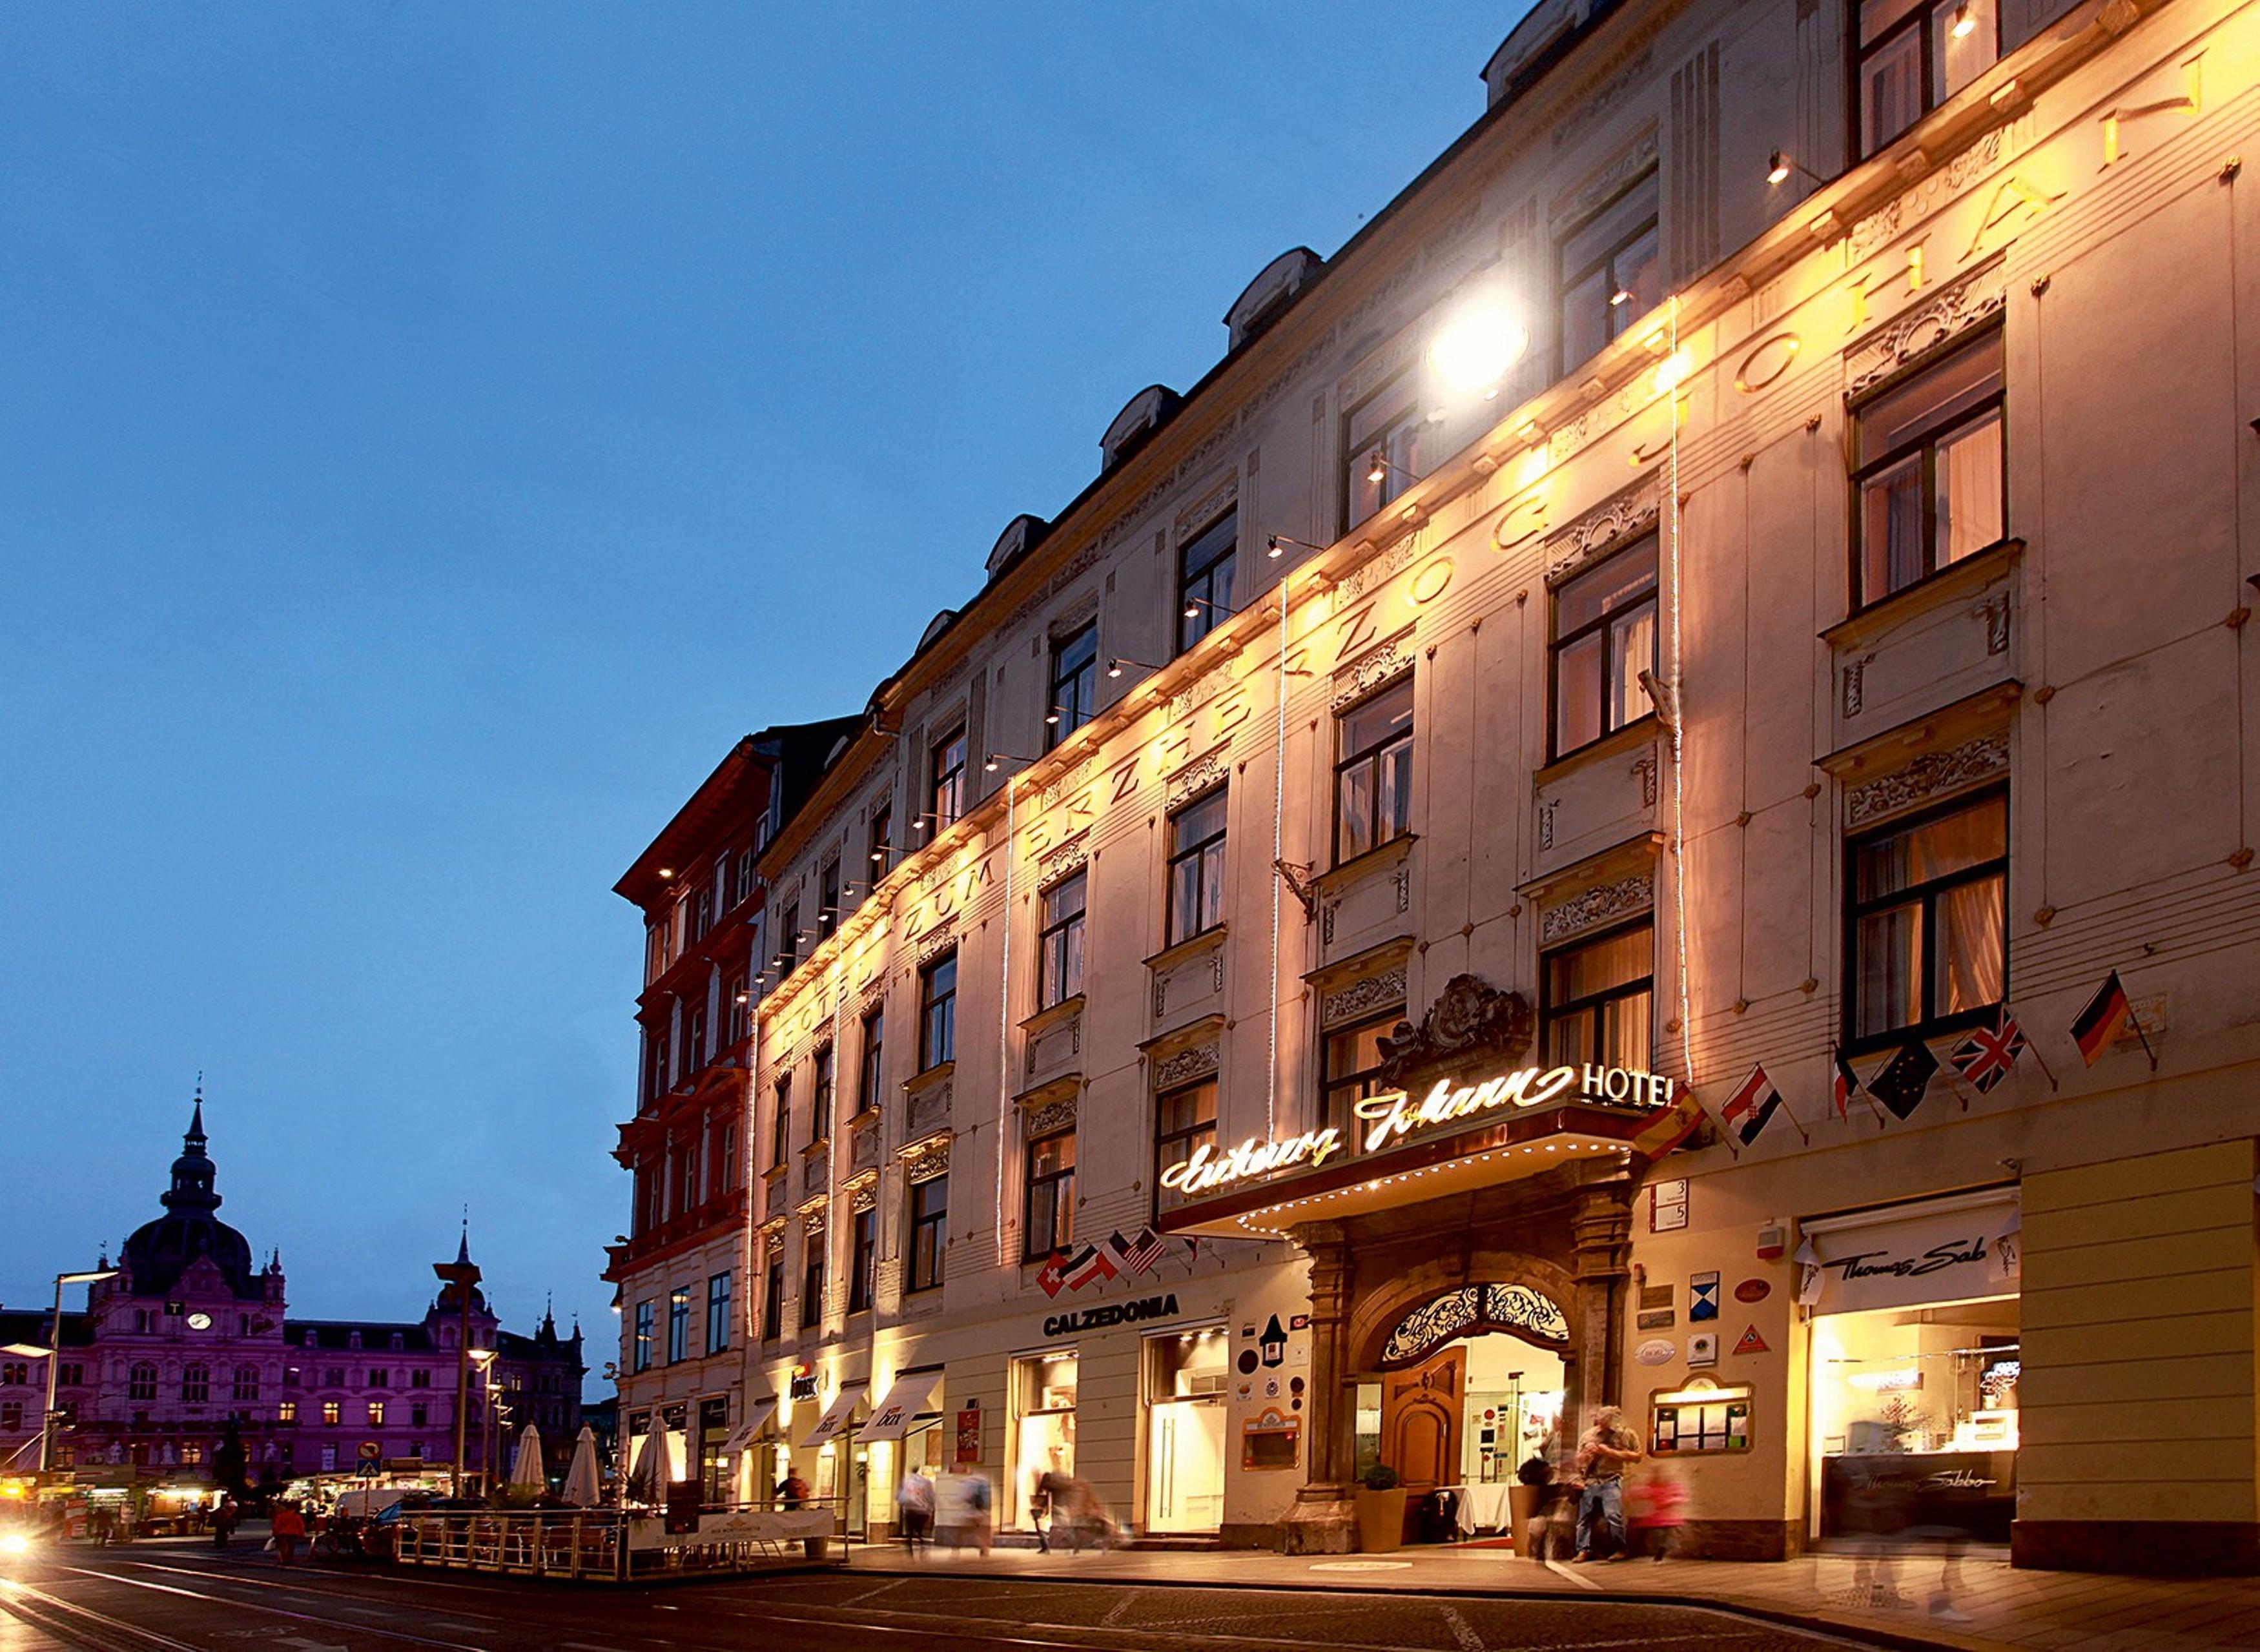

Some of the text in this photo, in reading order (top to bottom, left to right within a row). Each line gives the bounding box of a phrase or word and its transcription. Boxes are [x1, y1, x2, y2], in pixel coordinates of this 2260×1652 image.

[903, 857, 995, 941] ZUM
[1024, 495, 1551, 863] ERZHERZOG
[1353, 1065, 1574, 1152] Johann
[1678, 1181, 1685, 1194] 3
[1676, 1205, 1685, 1218] 5
[1821, 1251, 1915, 1281] Thomas
[169, 1303, 181, 1314] T
[1043, 1293, 1180, 1337] CALZEDONIA
[876, 1409, 906, 1427] box
